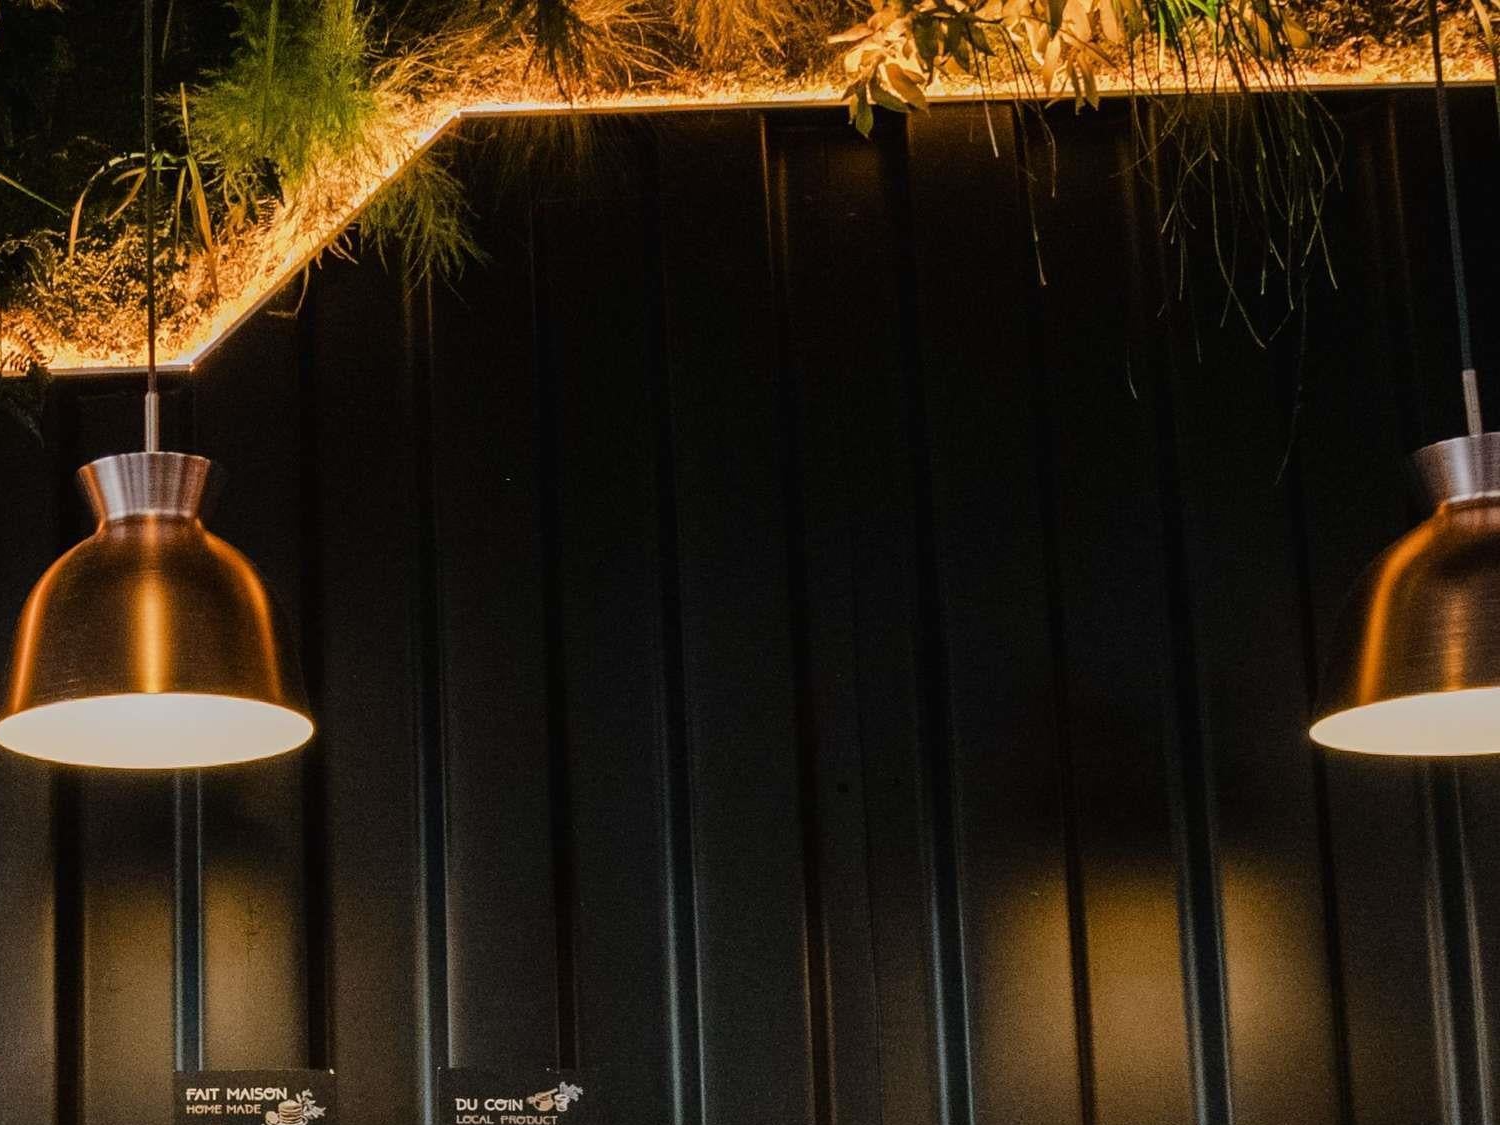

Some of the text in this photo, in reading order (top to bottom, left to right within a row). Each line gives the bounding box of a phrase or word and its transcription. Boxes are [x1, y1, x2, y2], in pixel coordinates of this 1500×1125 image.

[186, 1087, 288, 1101] FAIT MAISON
[186, 1104, 262, 1114] HOME MADE
[456, 1098, 523, 1111] DU COIN
[456, 1115, 558, 1125] LOCAL PRODUCT
